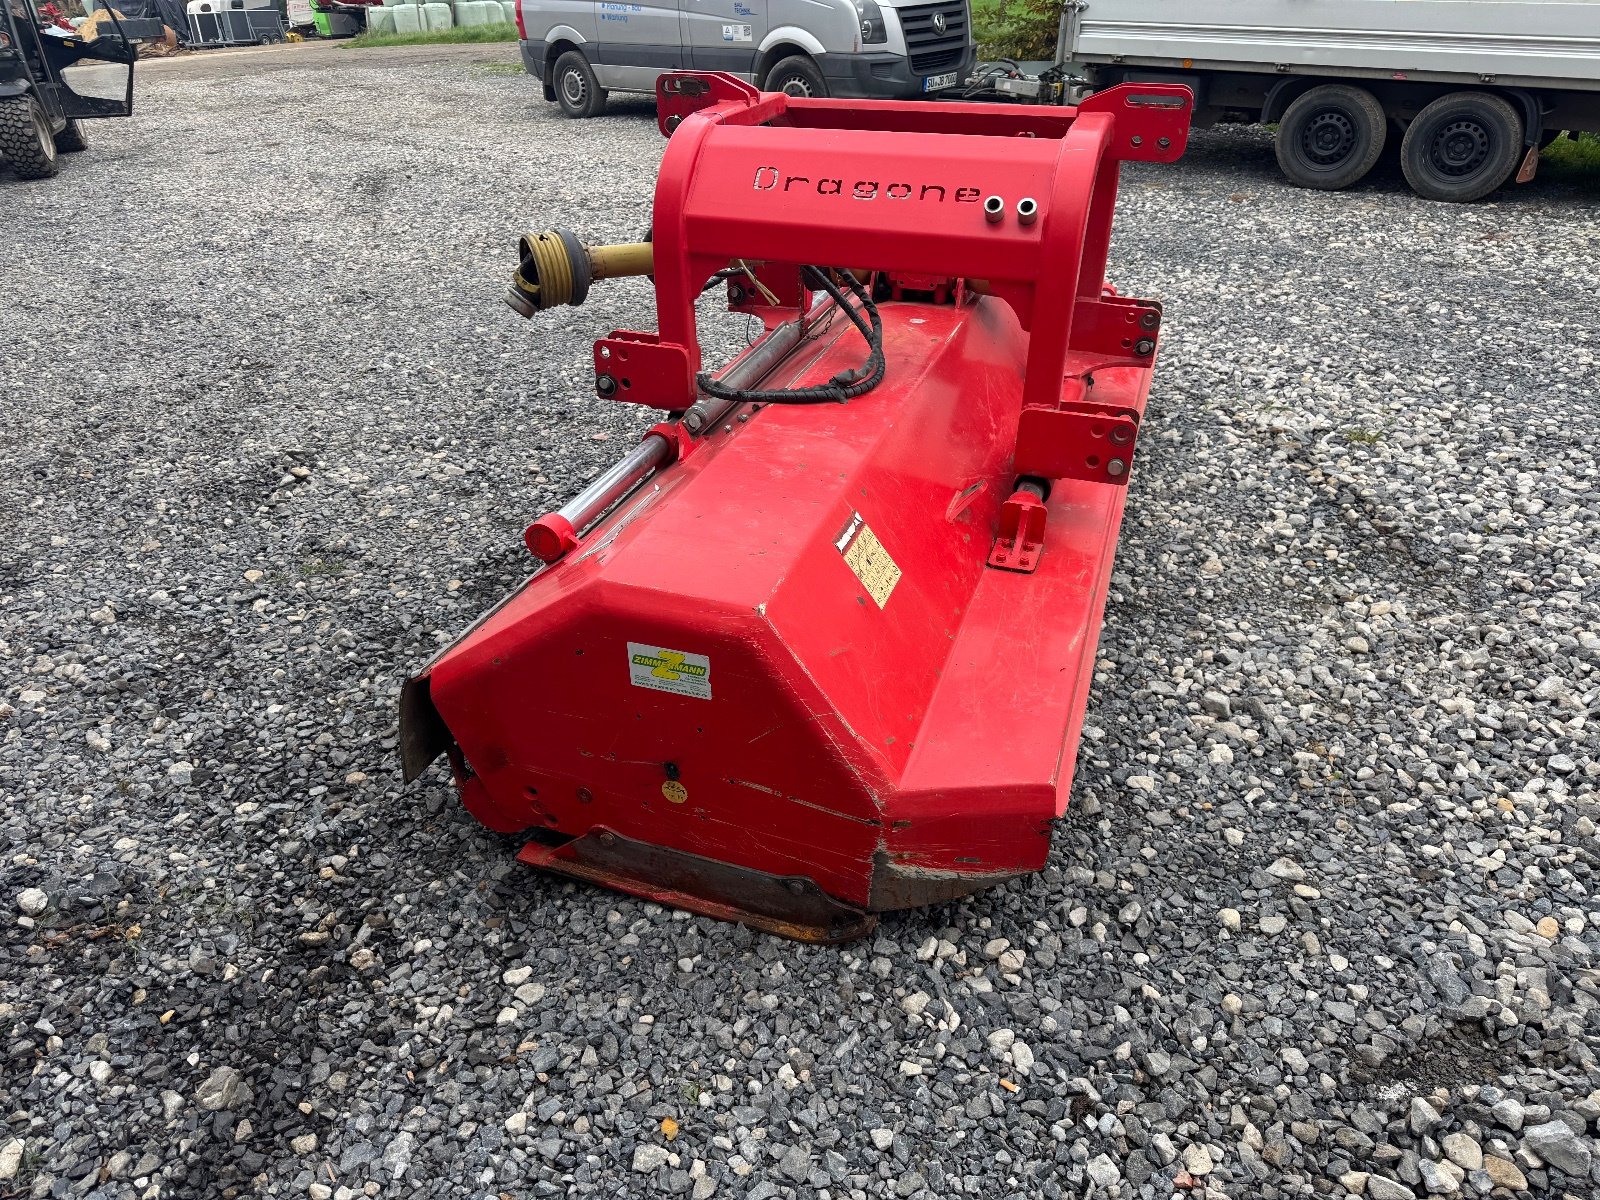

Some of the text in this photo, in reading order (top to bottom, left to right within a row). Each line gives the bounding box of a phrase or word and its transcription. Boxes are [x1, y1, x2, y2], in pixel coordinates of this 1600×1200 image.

[927, 78, 935, 88] SU
[753, 166, 981, 203] Dragone
[633, 655, 705, 675] ZIMMERMANN
